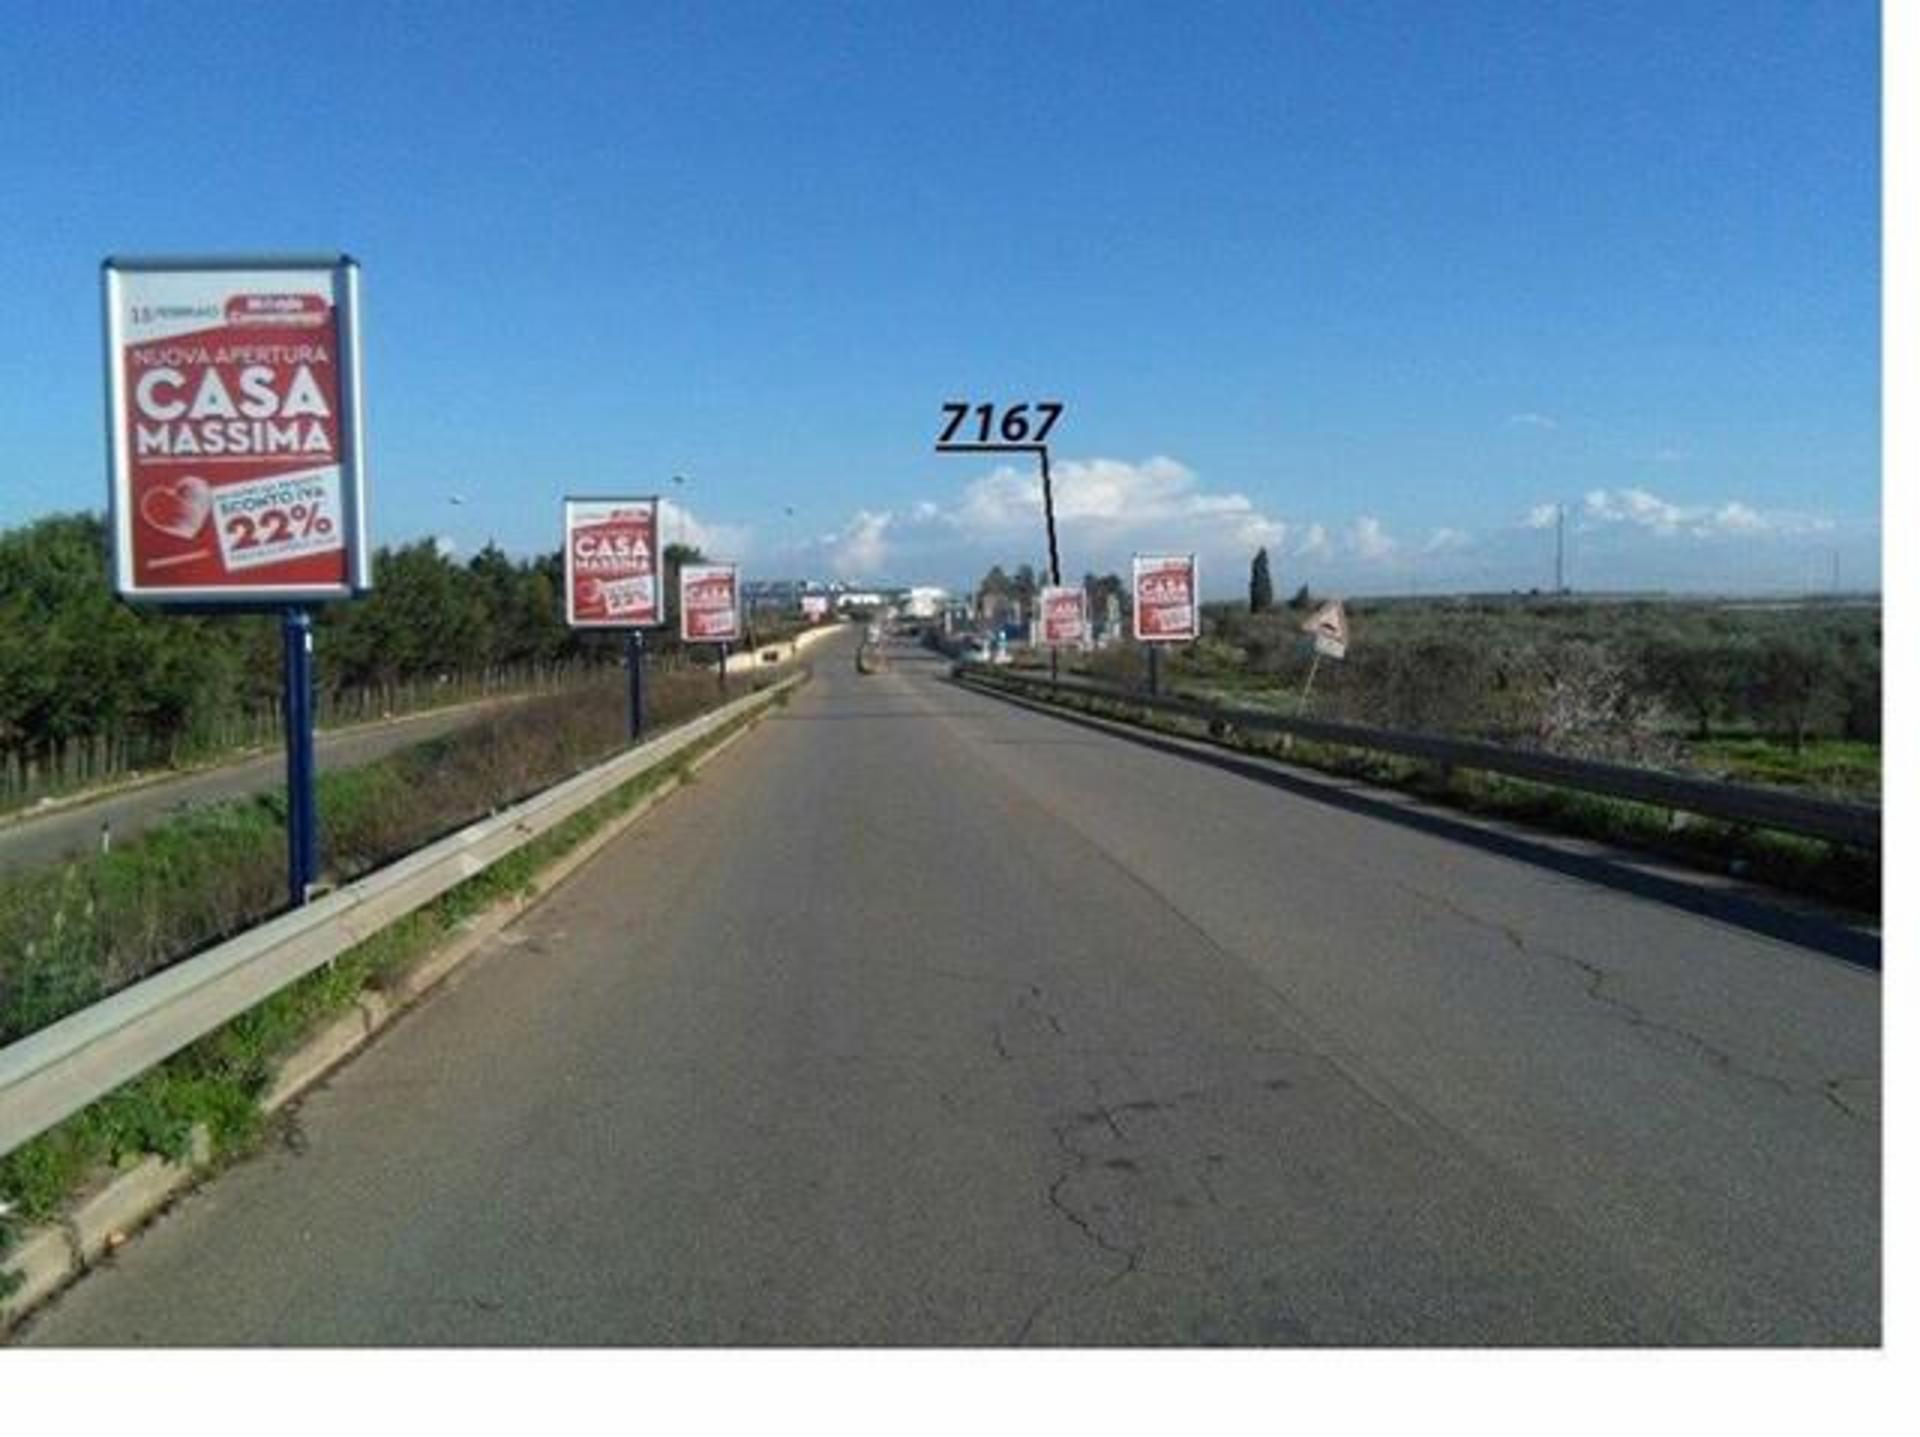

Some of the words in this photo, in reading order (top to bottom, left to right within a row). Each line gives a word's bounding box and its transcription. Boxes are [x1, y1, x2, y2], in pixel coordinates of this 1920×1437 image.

[134, 347, 211, 365] NUOVA
[215, 346, 329, 364] APERTURA
[136, 366, 330, 420] CASA
[137, 421, 331, 454] MASSIMA
[226, 503, 332, 551] 22%
[576, 537, 649, 557] CASA
